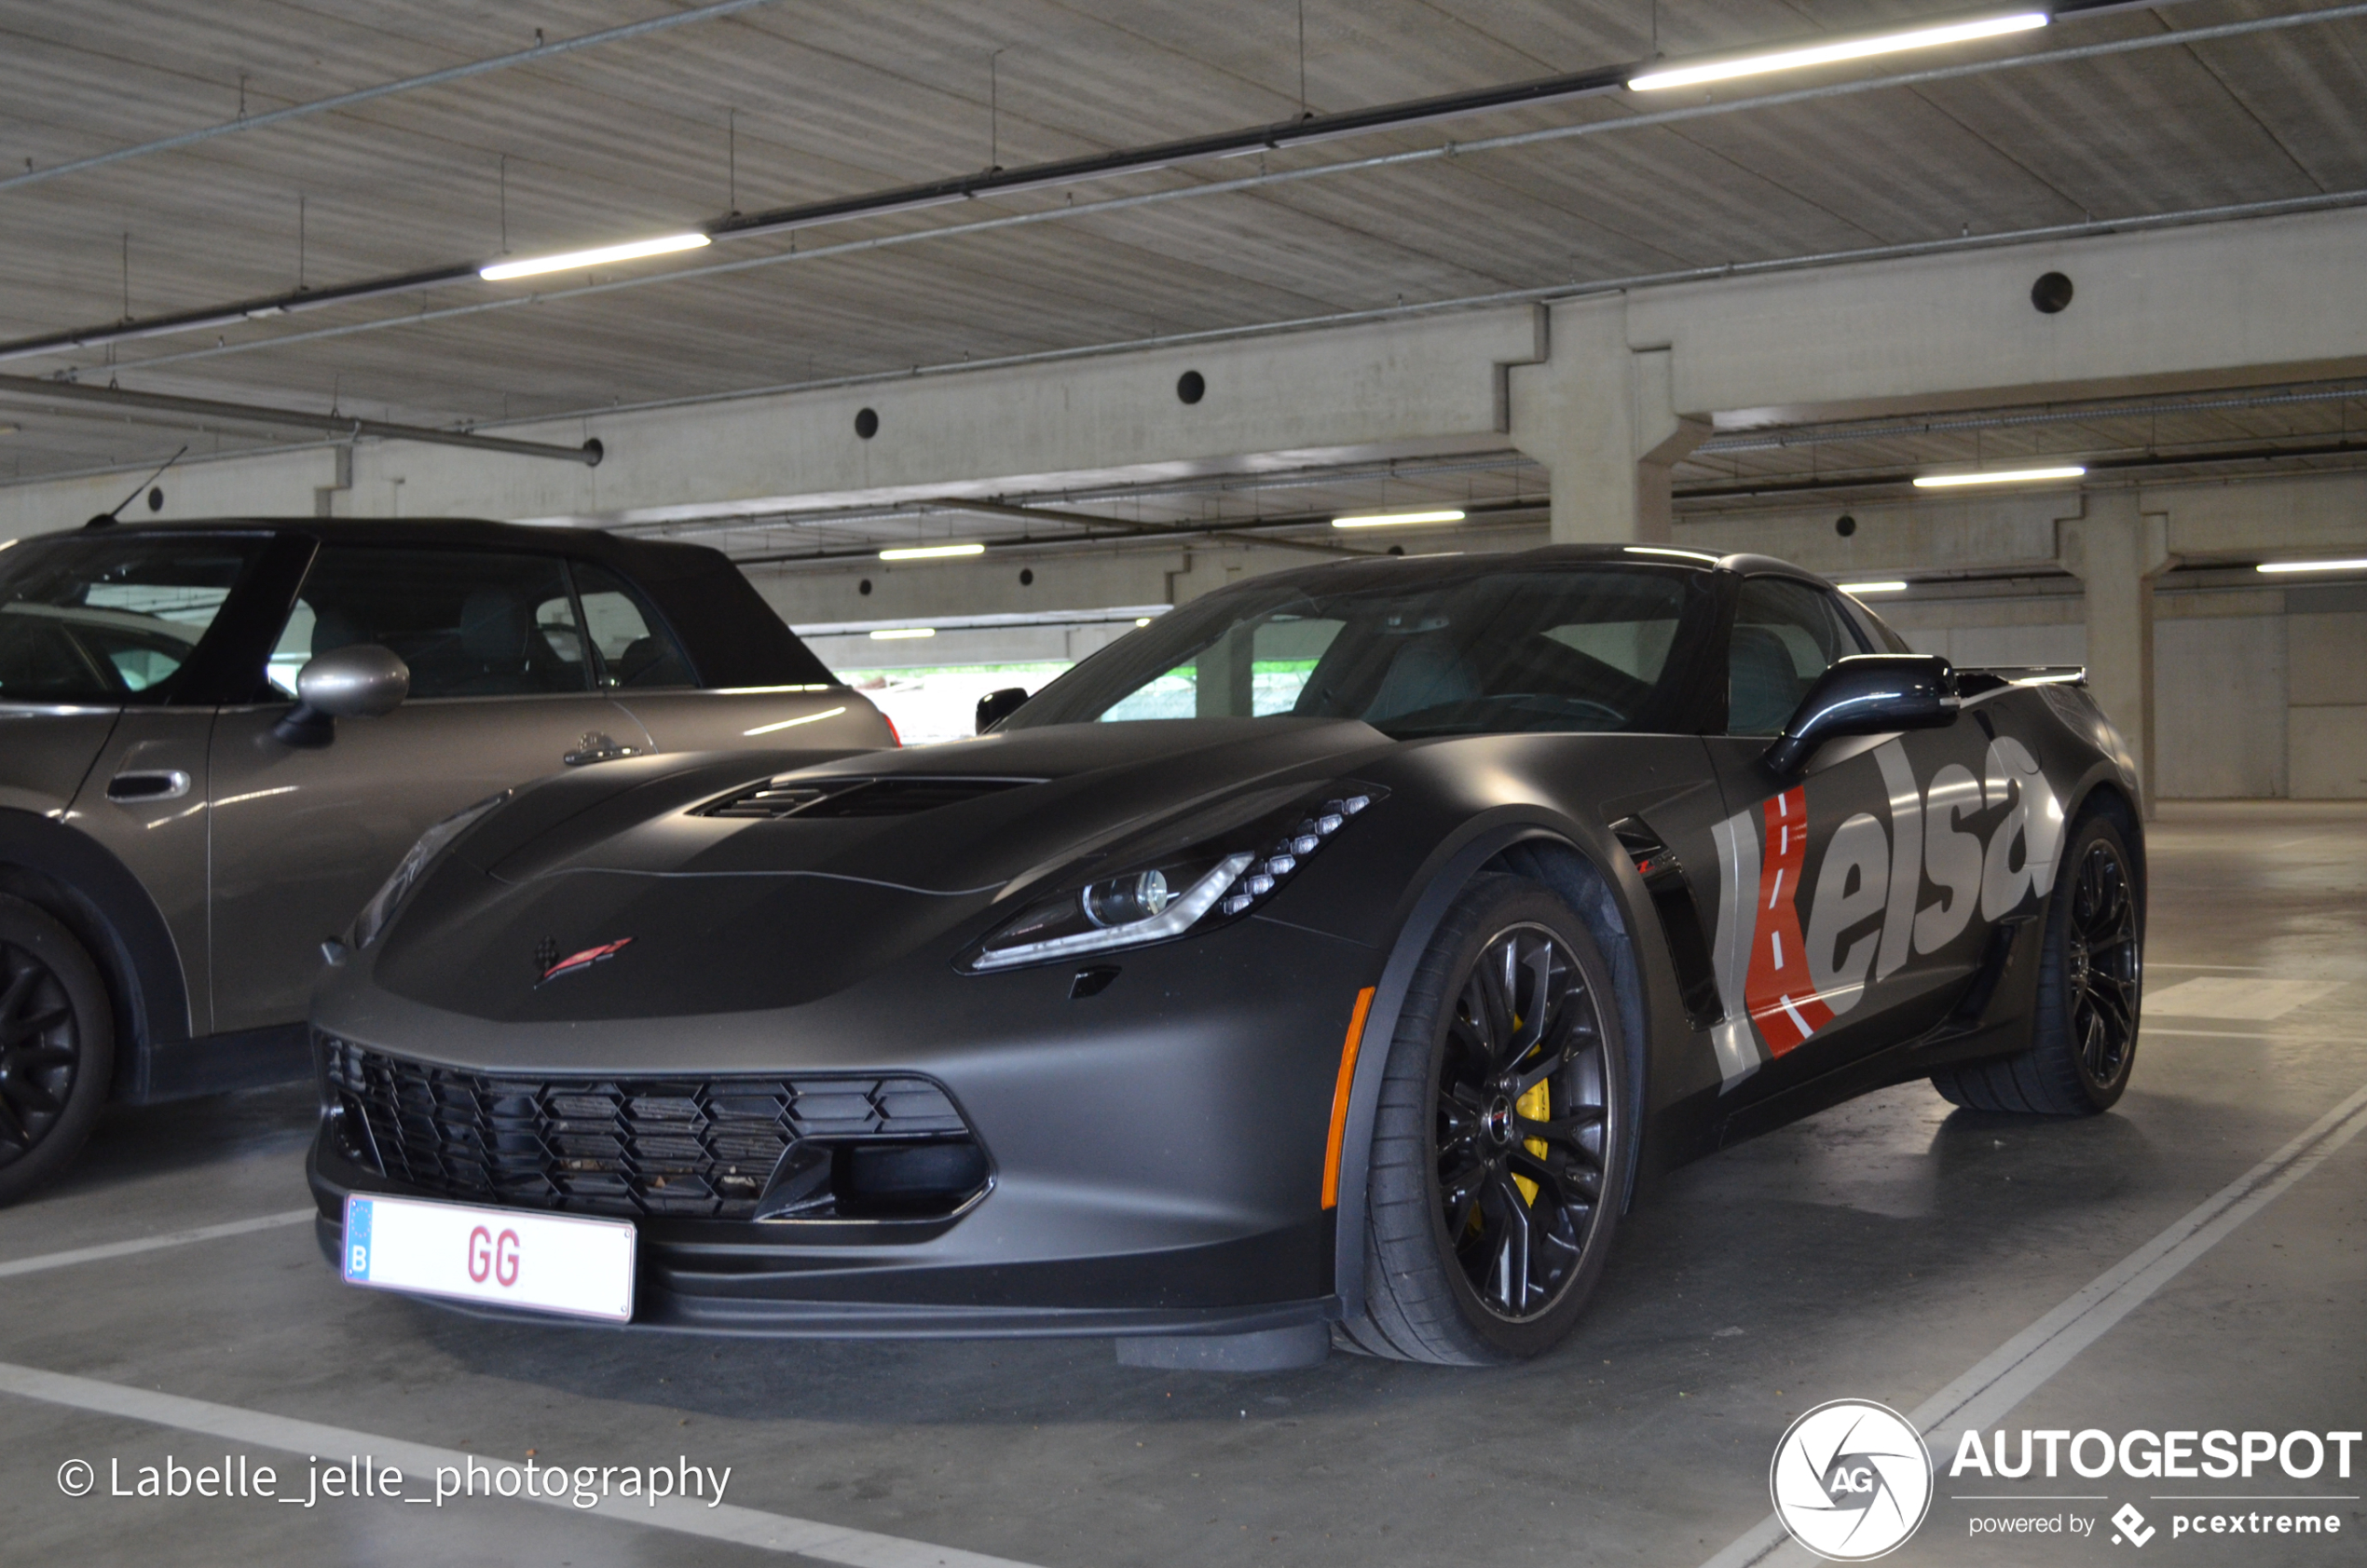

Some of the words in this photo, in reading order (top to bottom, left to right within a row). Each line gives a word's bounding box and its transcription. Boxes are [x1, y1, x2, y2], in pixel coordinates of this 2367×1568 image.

[1711, 736, 2065, 1097] Kelsa
[350, 1245, 368, 1273] B
[468, 1225, 521, 1287] GG
